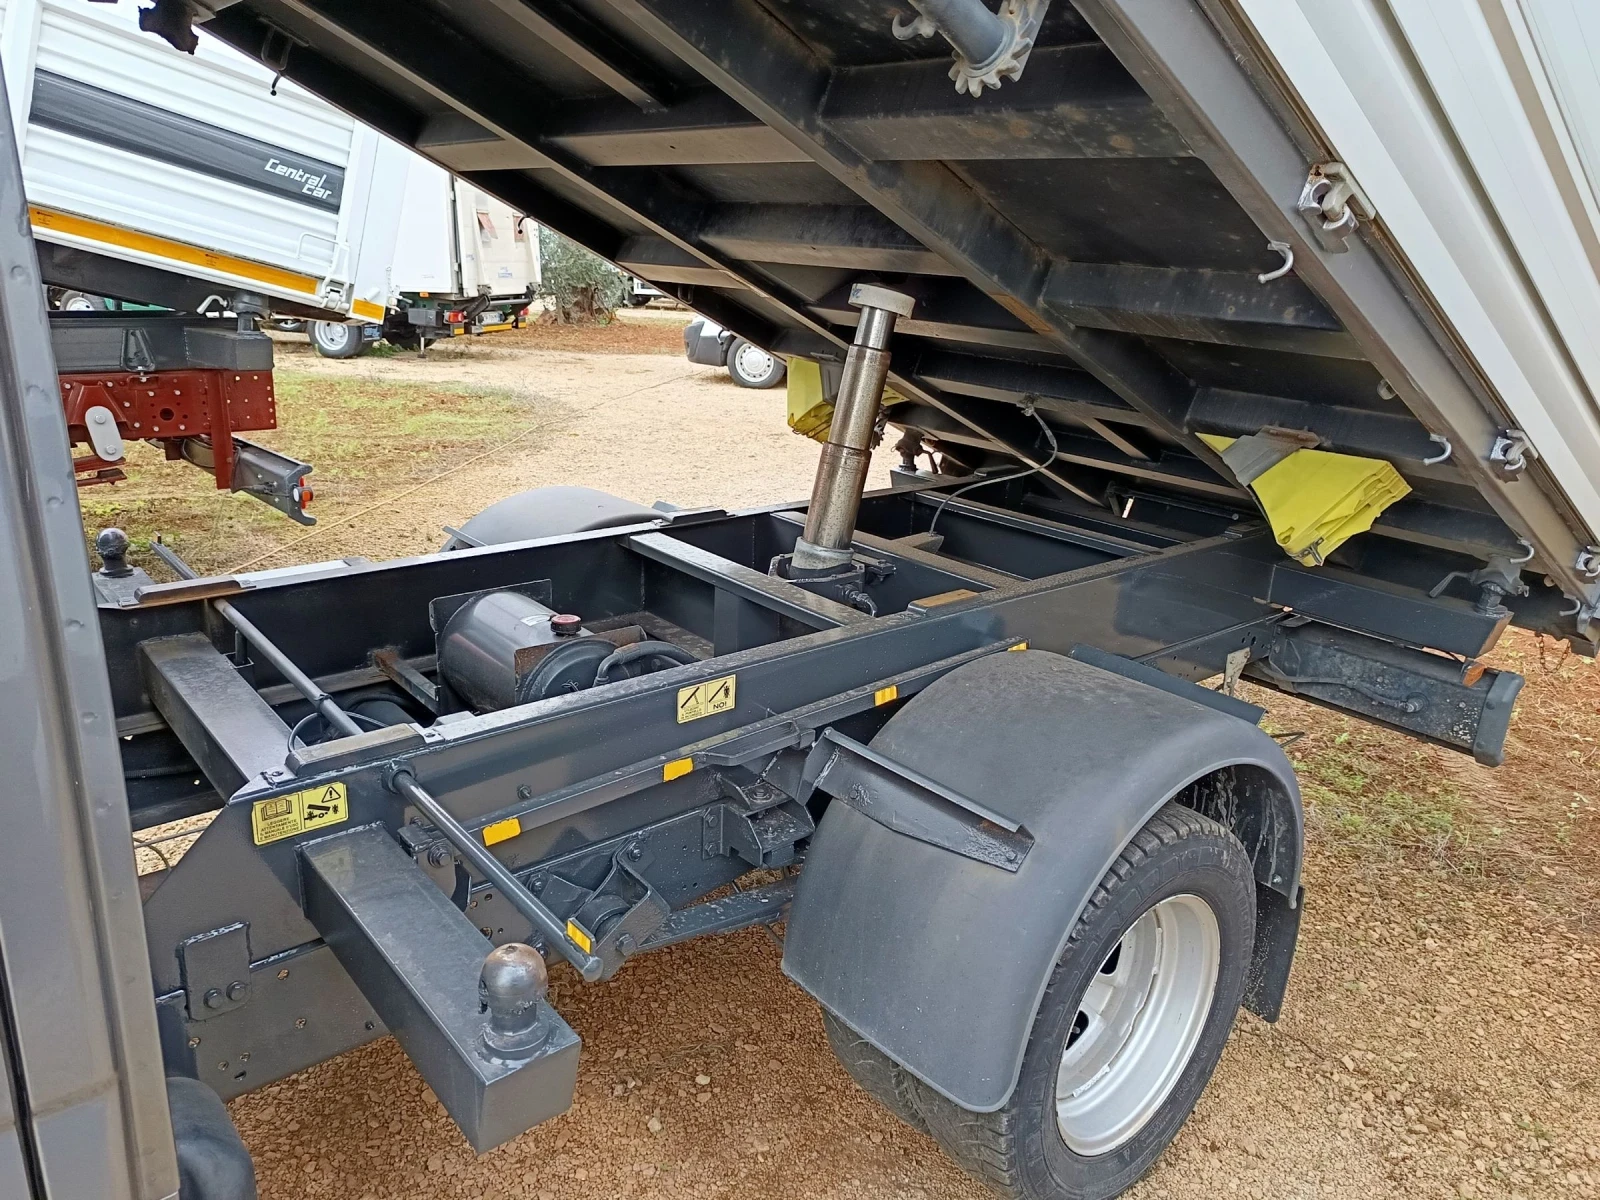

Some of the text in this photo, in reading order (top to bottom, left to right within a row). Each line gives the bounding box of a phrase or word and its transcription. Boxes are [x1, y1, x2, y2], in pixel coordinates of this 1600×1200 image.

[264, 158, 327, 188] Central
[713, 701, 727, 710] NO!
[261, 819, 297, 832] ATTENTAMENTE
